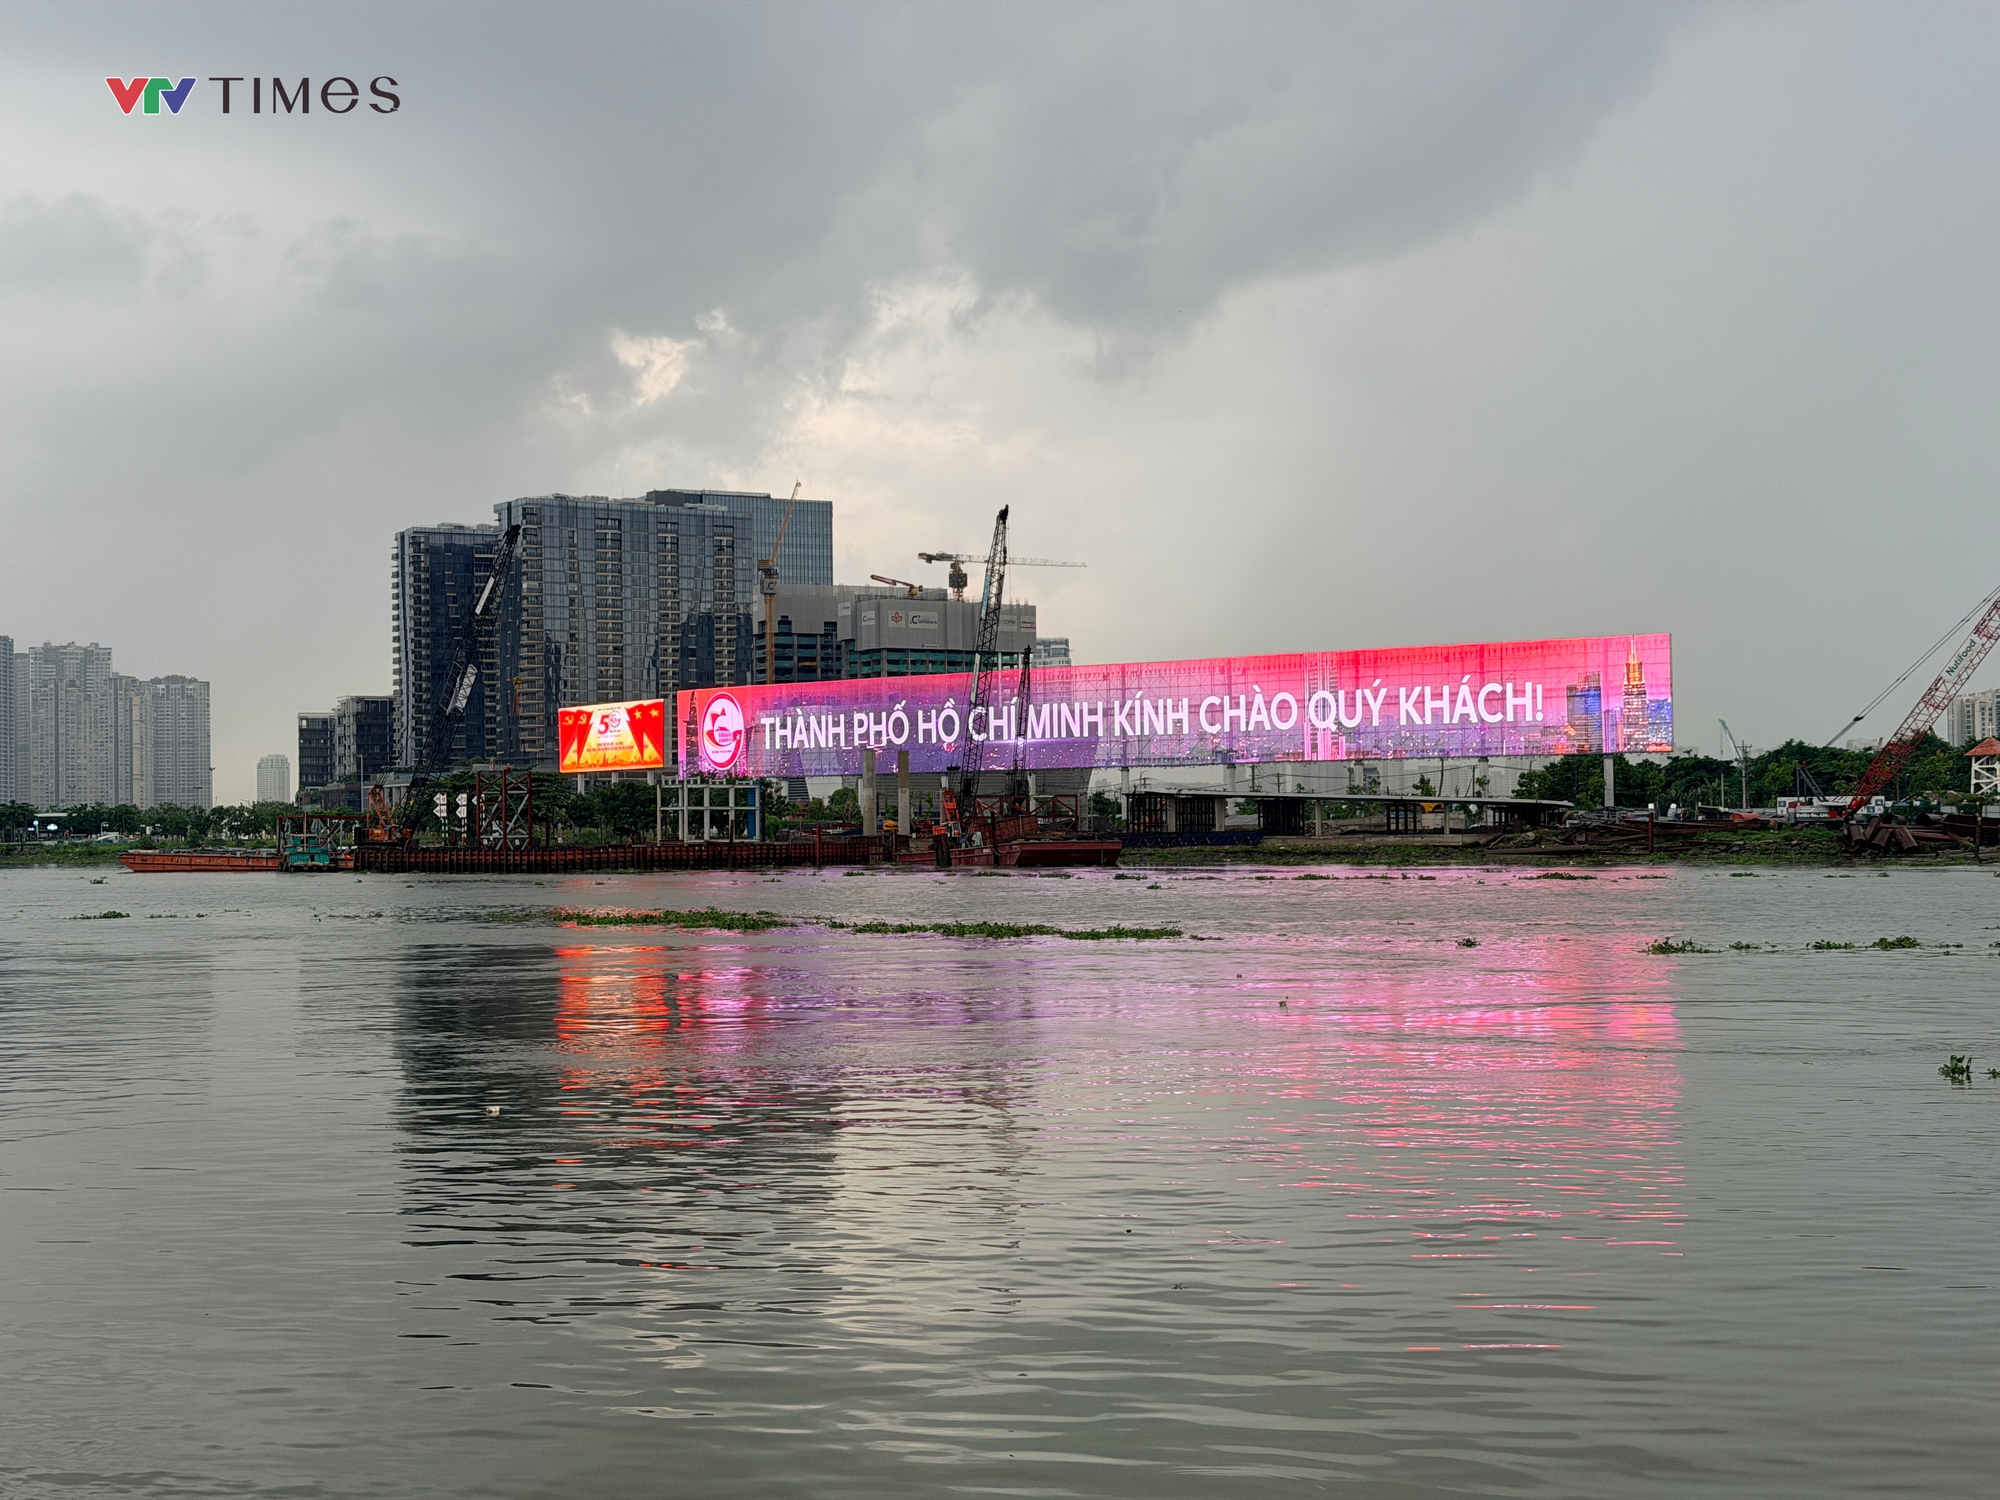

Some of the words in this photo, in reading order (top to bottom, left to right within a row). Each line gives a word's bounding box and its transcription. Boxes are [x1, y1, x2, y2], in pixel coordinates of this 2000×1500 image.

[1945, 638, 1977, 676] Nutifood
[760, 707, 846, 750] THÀNH
[854, 700, 910, 747] PHỐ
[918, 698, 960, 744] HỒ
[968, 696, 1018, 742] CHÍ
[1027, 701, 1104, 739] MINH
[1114, 690, 1189, 736] KÍNH
[1199, 684, 1298, 733] CHÀO
[1308, 678, 1387, 732] QUÝ
[1400, 674, 1544, 726] KHÁCH!
